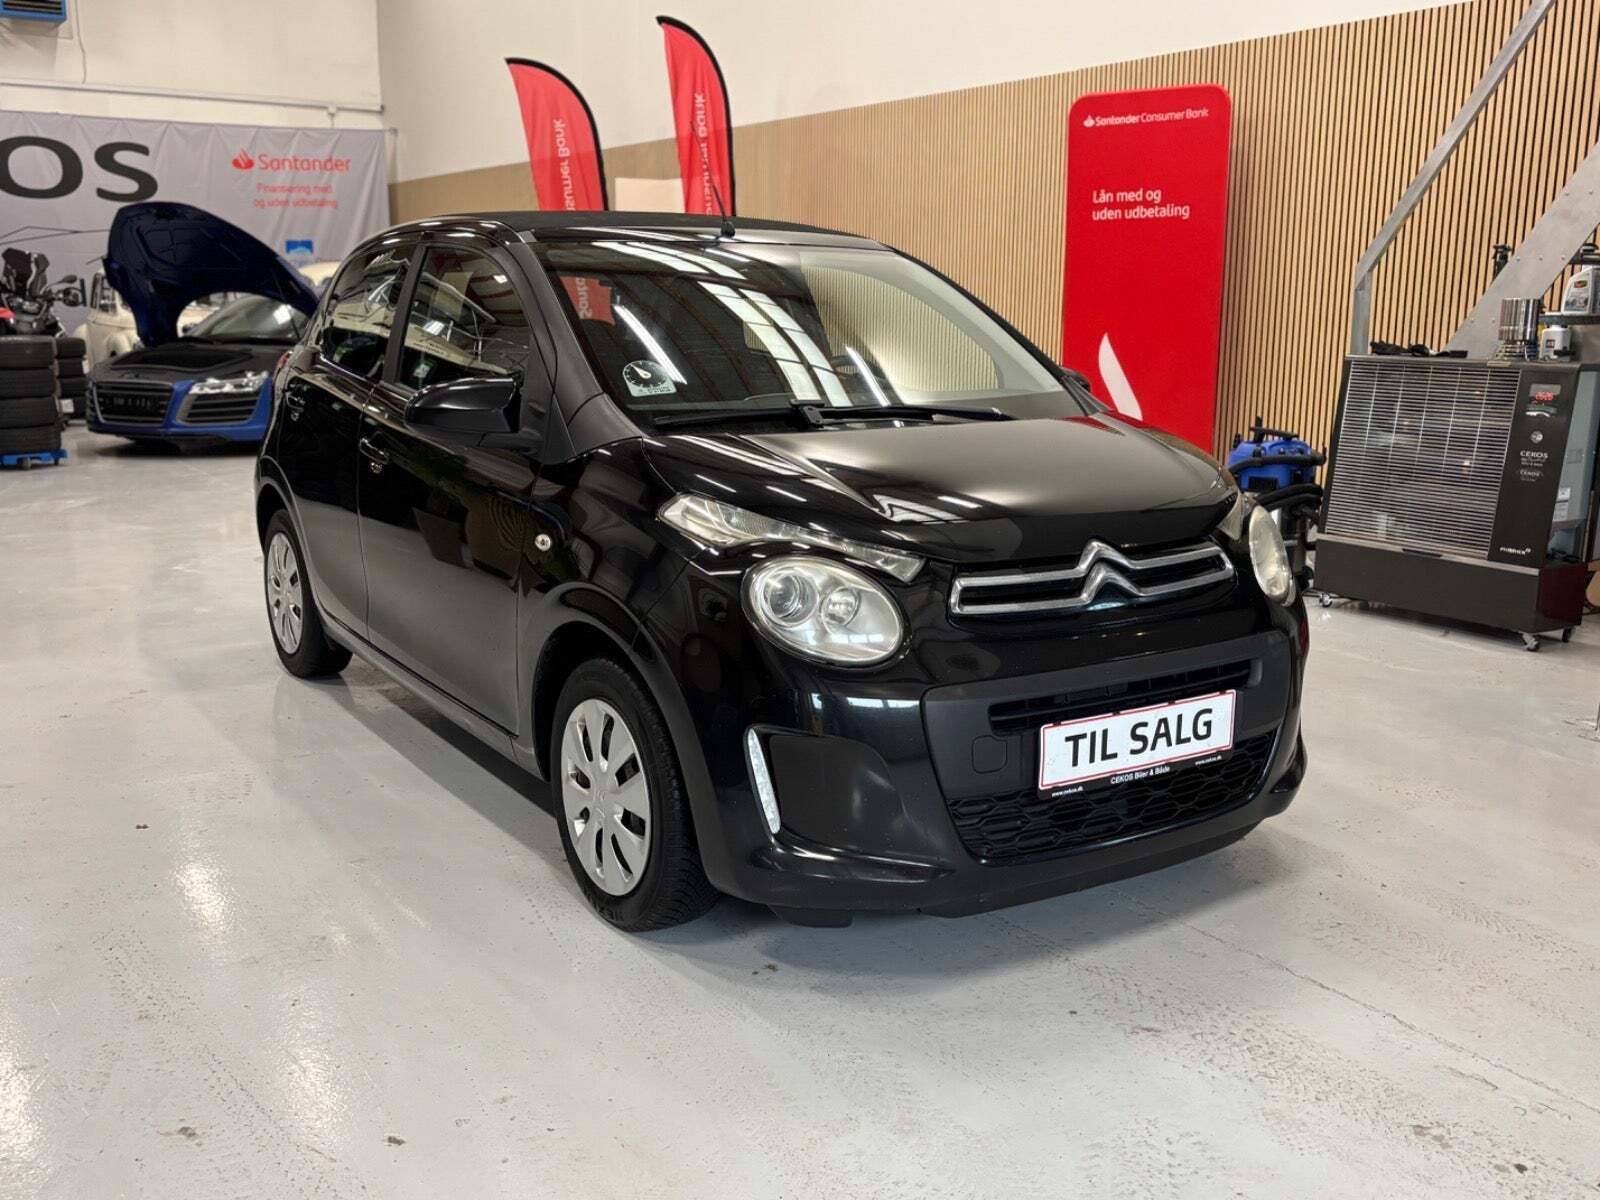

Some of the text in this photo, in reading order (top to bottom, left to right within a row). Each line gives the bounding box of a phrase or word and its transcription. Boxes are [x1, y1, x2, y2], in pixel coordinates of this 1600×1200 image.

[1095, 107, 1209, 127] Santander Consumer Bank
[0, 135, 159, 203] OS
[258, 154, 351, 172] Santander
[1092, 188, 1162, 203] Lån med og
[1092, 203, 1190, 221] uden udbetaling
[1065, 708, 1213, 767] TIL SALG
[1110, 773, 1134, 785] CEKOS
